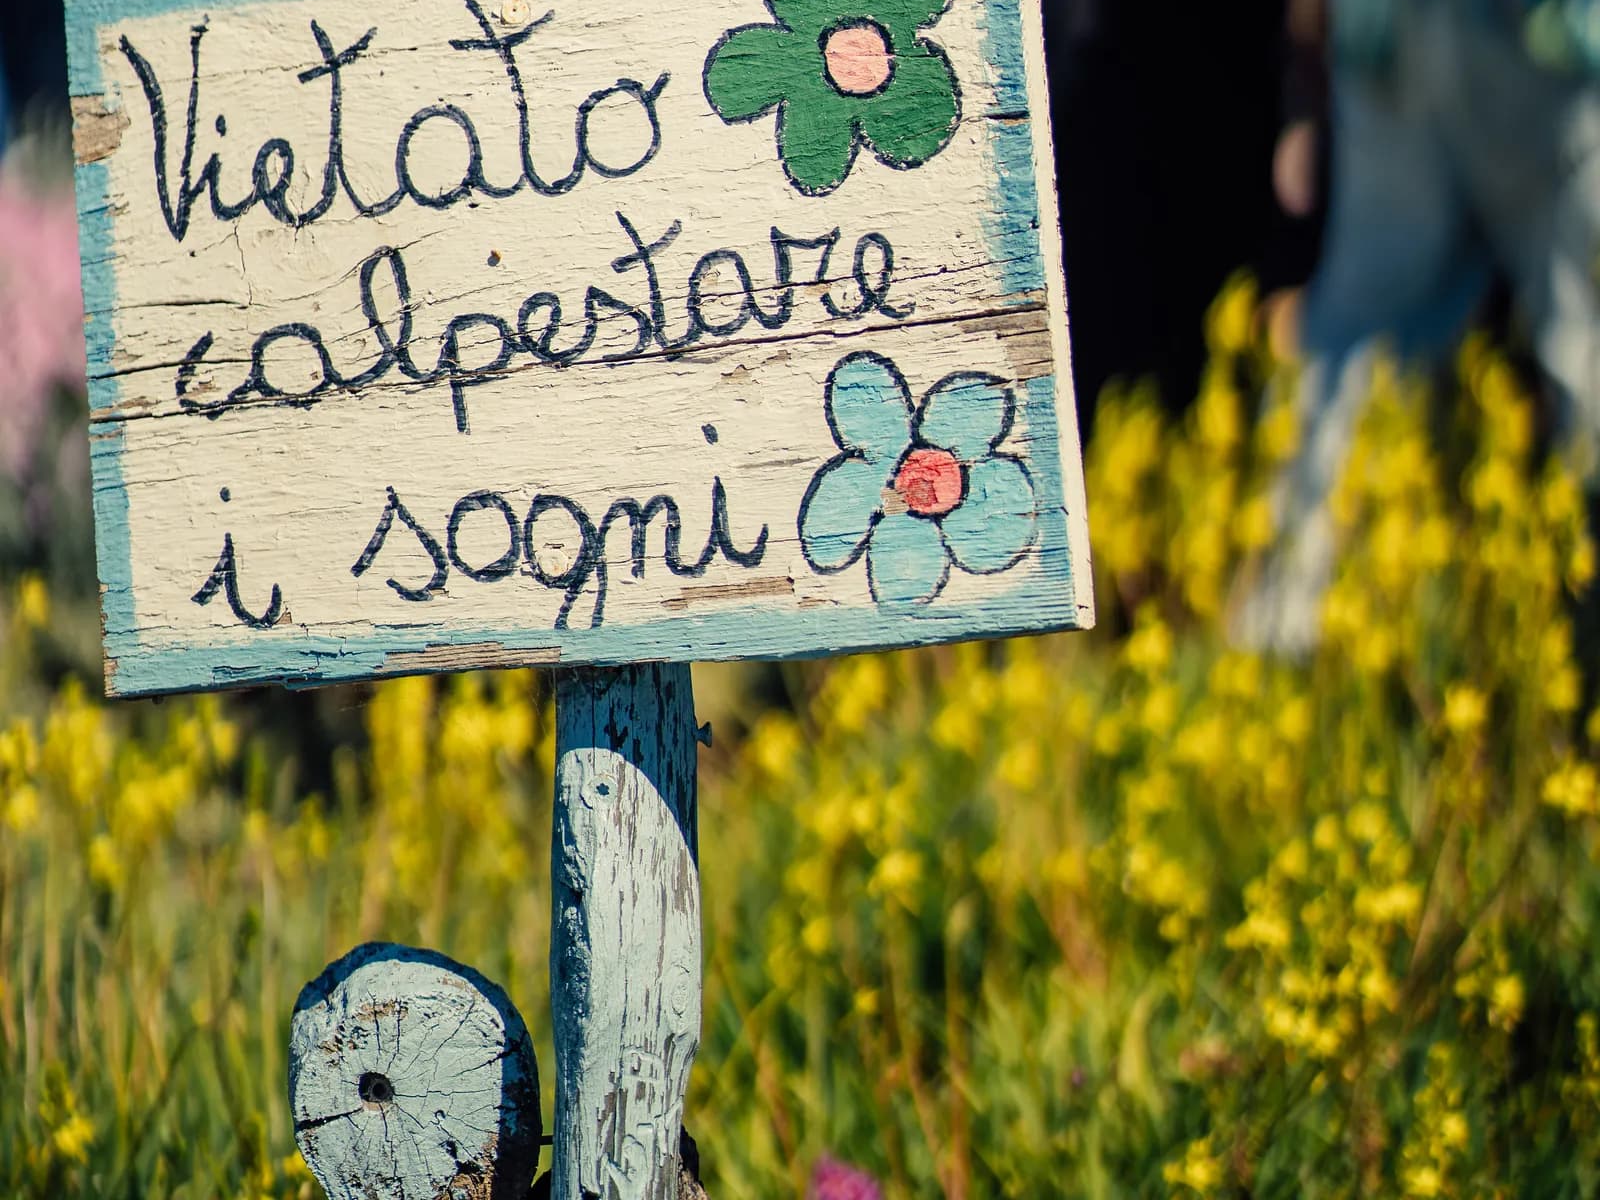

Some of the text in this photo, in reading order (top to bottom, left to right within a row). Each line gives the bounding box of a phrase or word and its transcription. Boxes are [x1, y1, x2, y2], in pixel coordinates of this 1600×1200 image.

[177, 211, 915, 435] calpestare
[190, 423, 769, 630] i sogni
